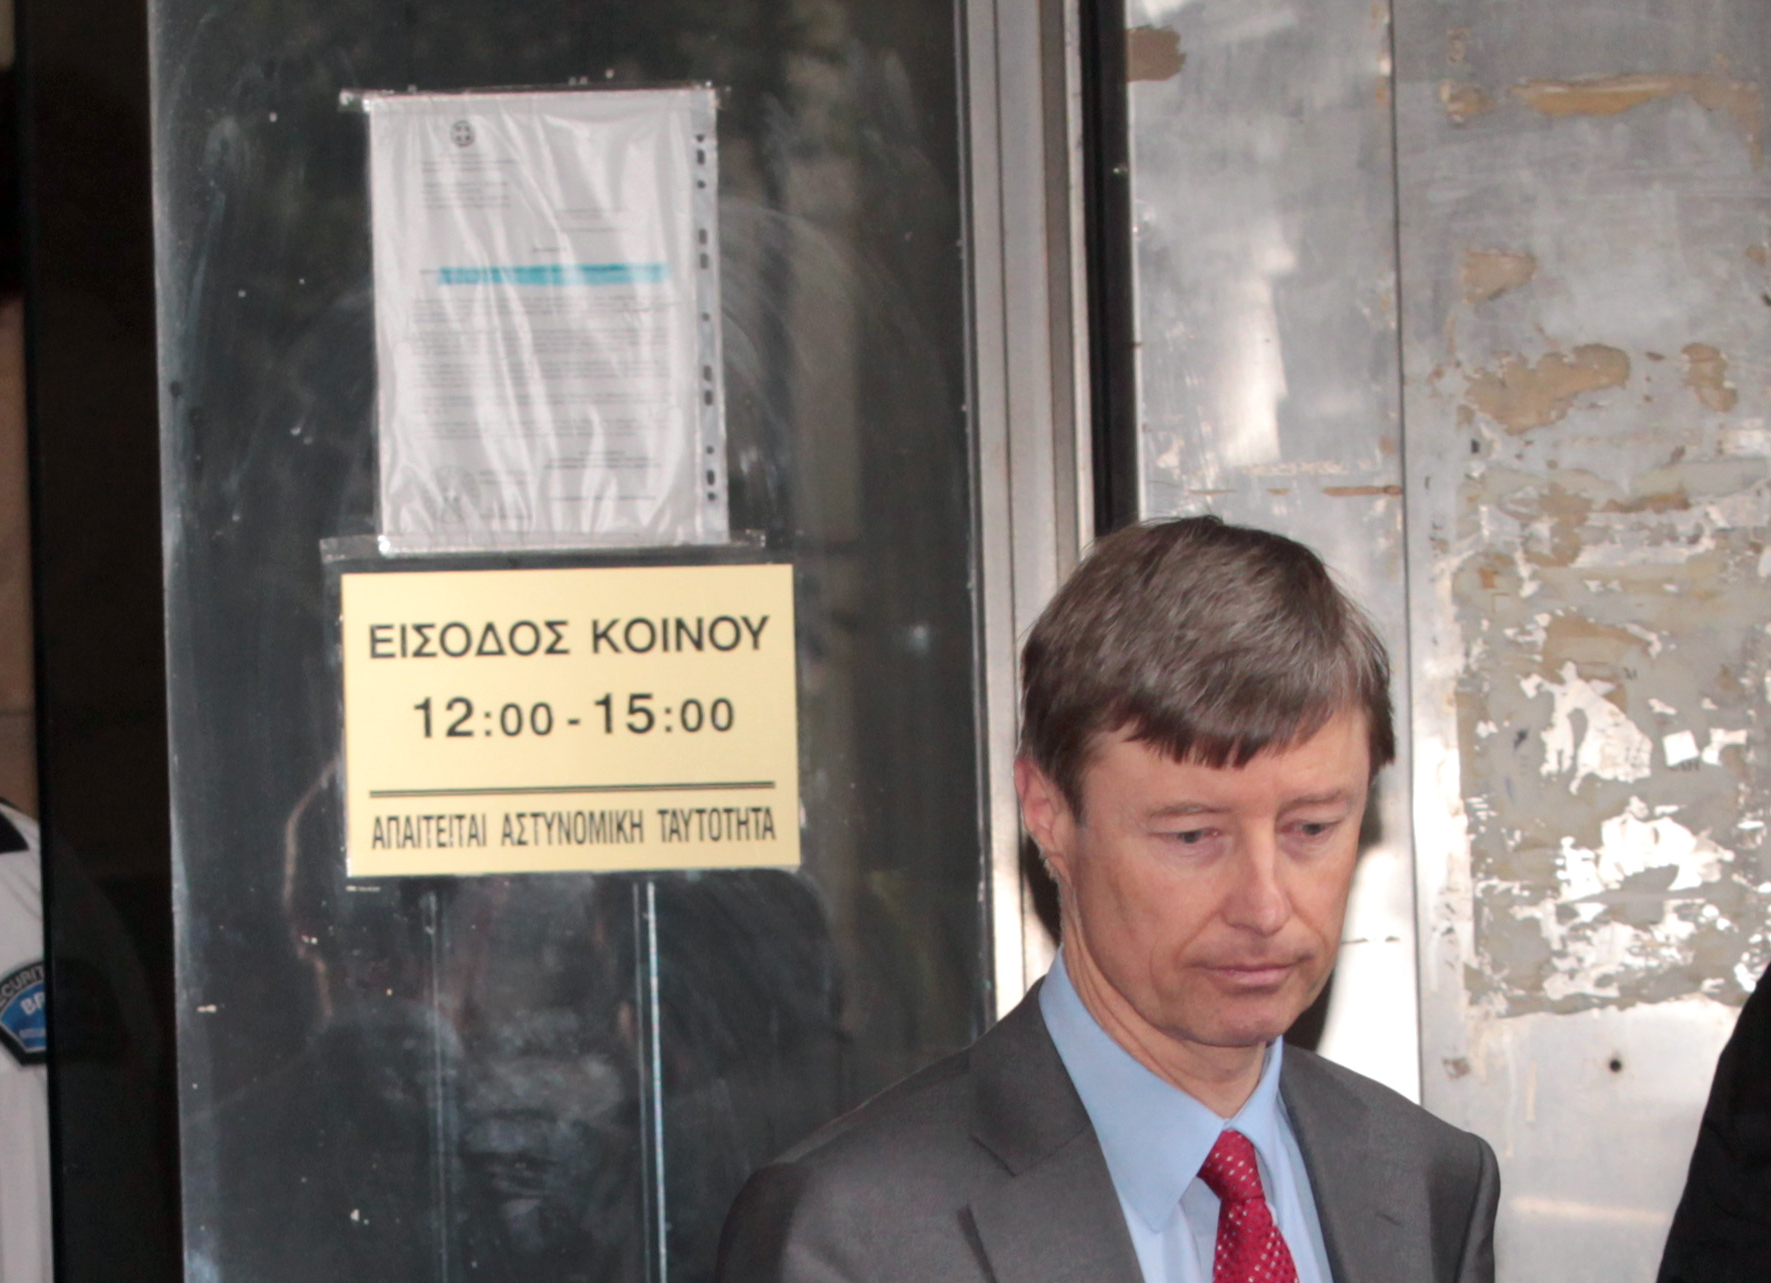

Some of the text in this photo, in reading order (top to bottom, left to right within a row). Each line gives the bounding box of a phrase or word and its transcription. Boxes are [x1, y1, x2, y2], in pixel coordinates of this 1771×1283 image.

[369, 615, 769, 659] ΕΙΣΟΔΟΣ ΚΟΙΝΟΥ
[373, 806, 776, 848] ΑΠΑΙΤΕΙΤΑΙ ΑΣΤΥΝΟΜΙΚΗ ΤΑΥΤΟΤΗΤΑ
